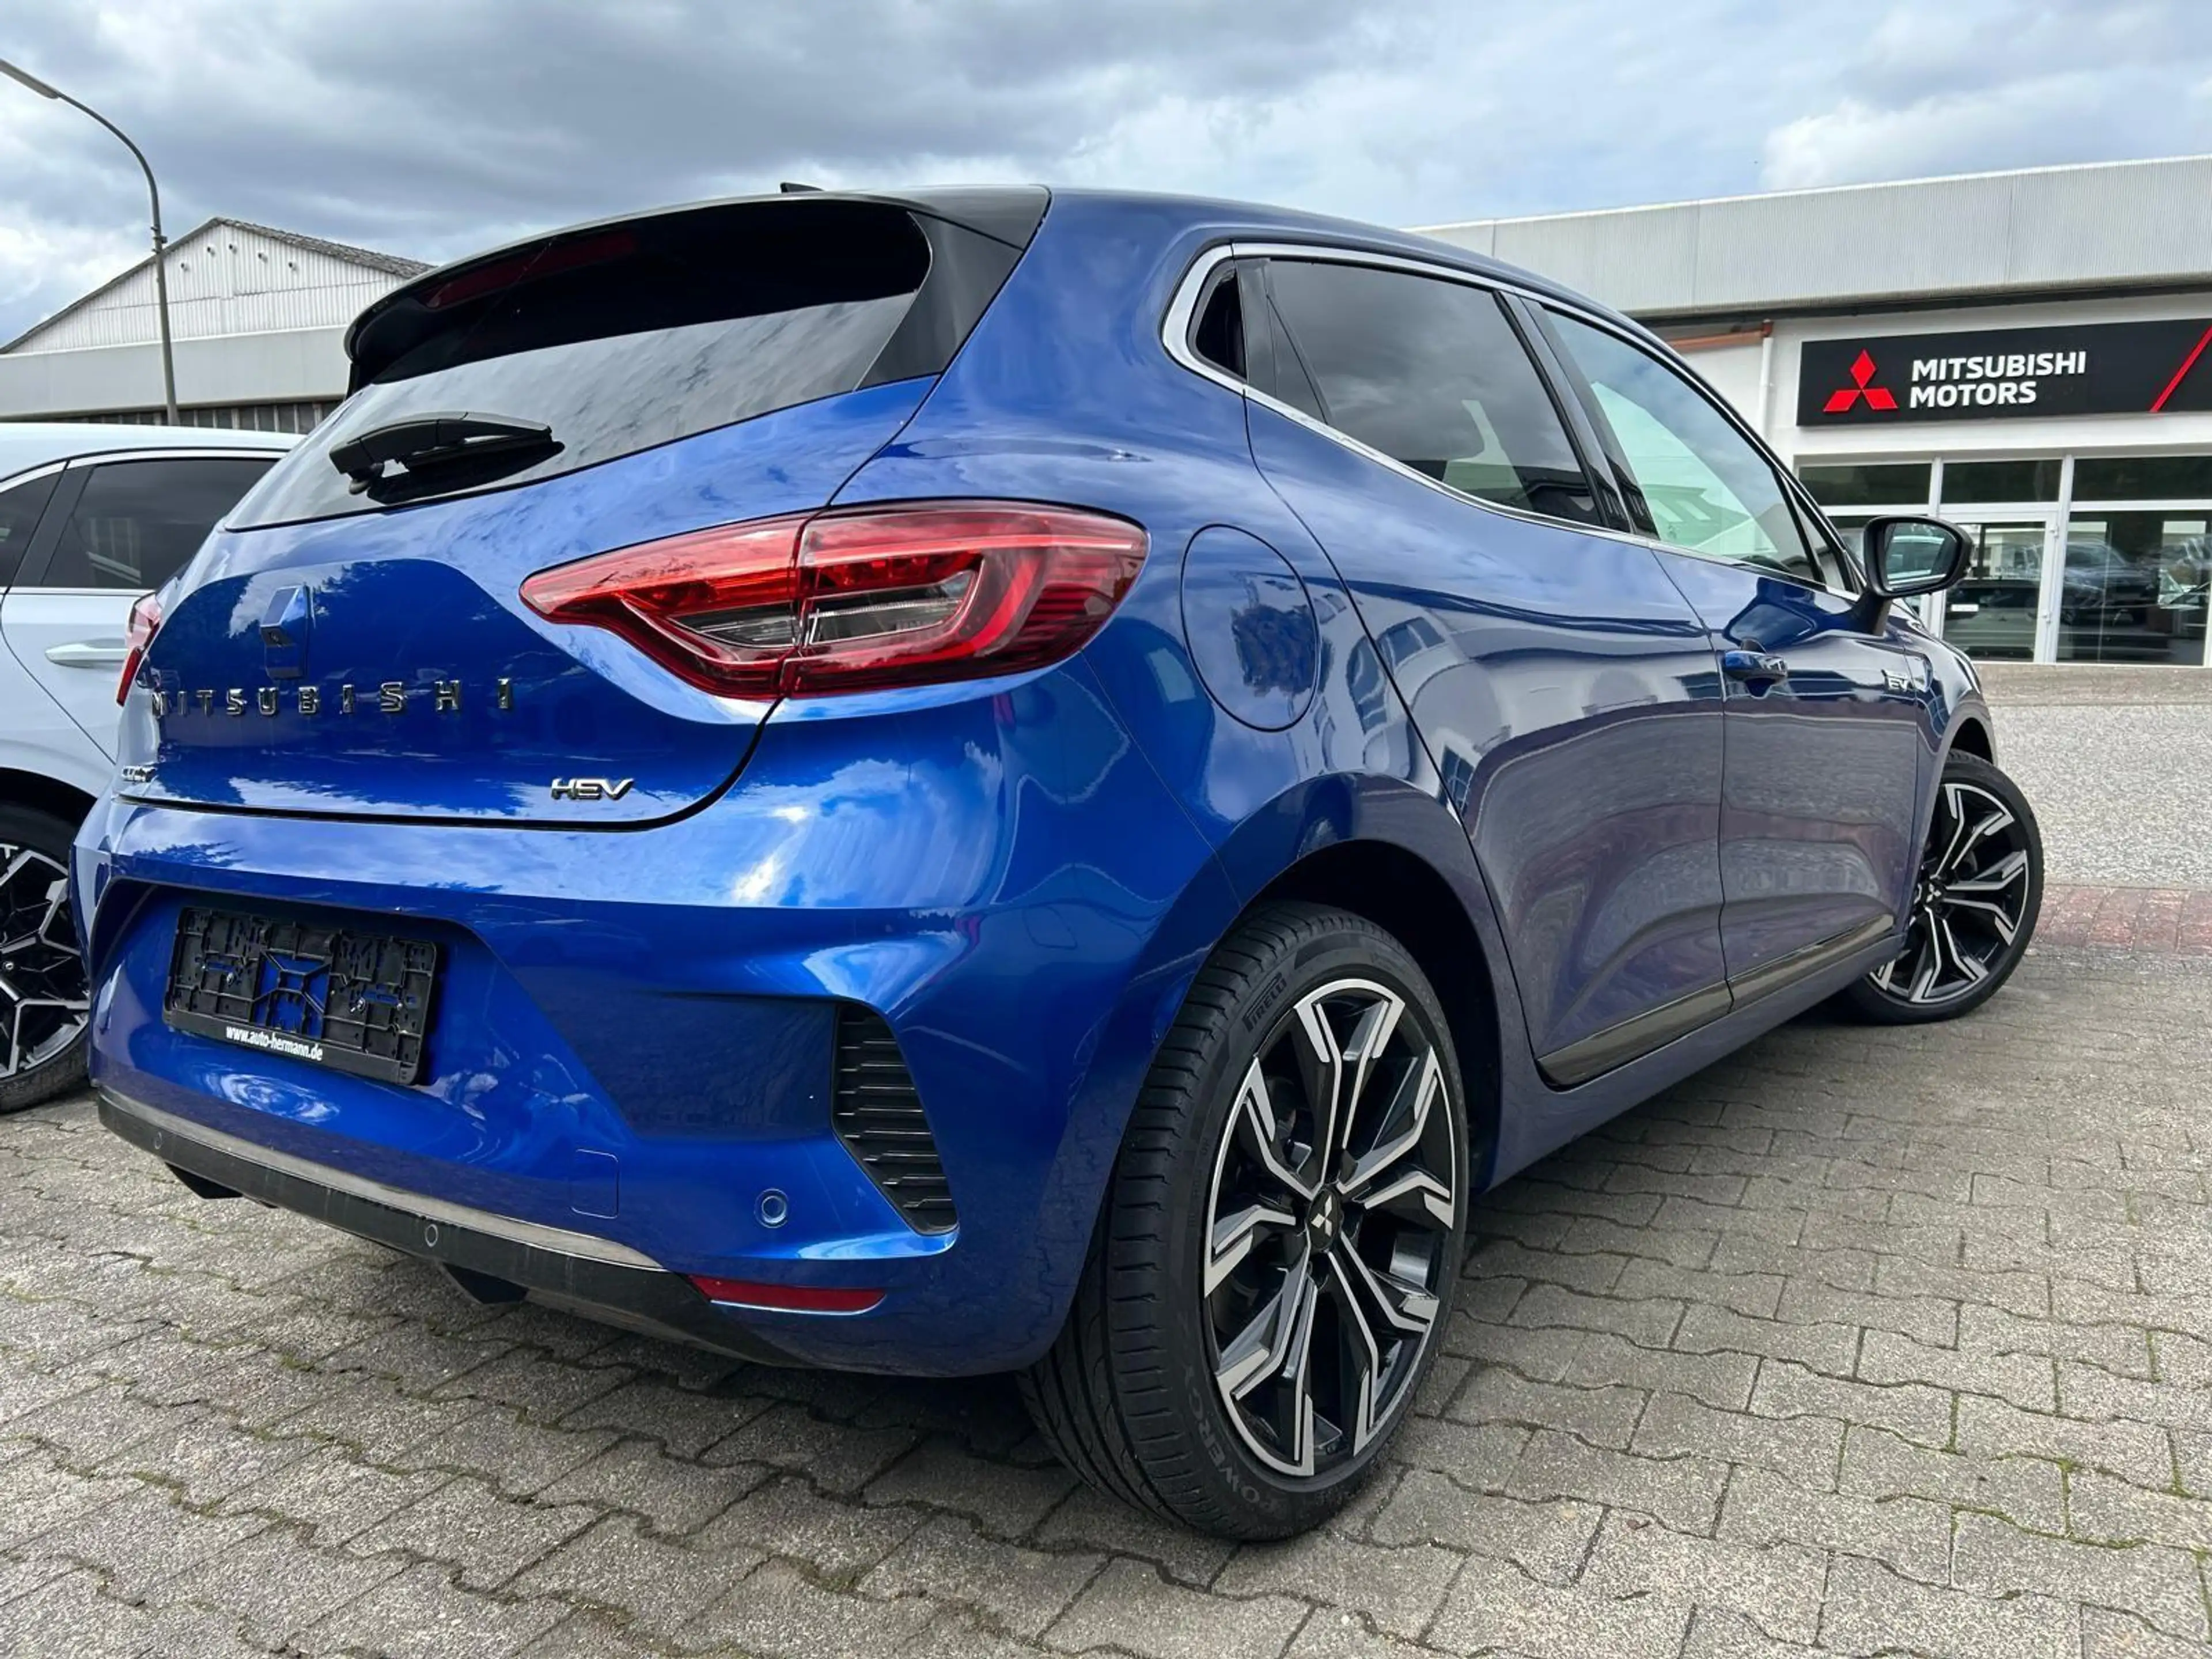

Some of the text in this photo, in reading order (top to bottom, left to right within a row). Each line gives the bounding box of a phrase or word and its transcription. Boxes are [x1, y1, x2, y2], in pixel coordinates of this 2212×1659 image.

[1911, 350, 2086, 381] MITSUBISHI
[1910, 381, 2037, 408] MOTORS
[151, 677, 514, 717] MITSUBISHI
[551, 778, 634, 800] HEV
[225, 1025, 323, 1061] www.auto-hermann.de
